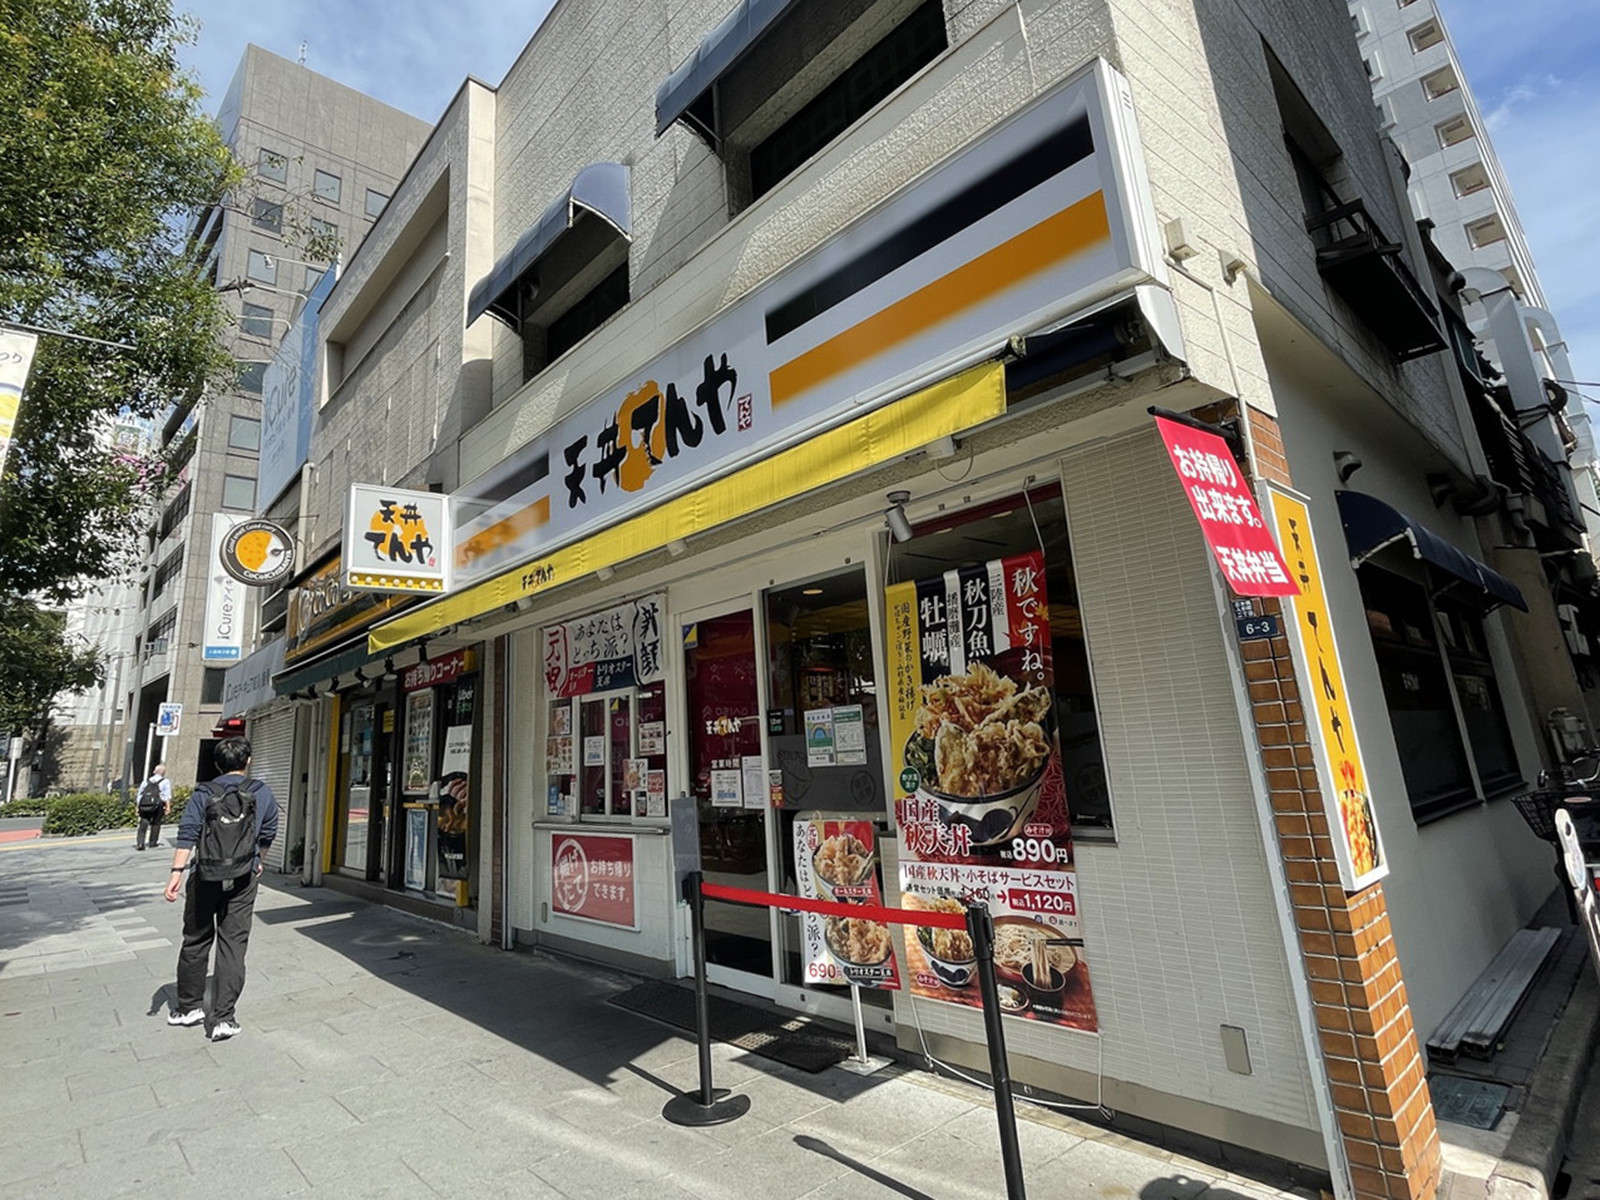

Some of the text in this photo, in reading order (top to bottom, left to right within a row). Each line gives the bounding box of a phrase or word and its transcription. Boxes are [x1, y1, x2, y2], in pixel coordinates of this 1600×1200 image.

[564, 352, 738, 509] 天丼てんや
[738, 393, 752, 432] てんや
[1174, 444, 1238, 489] お持帰り
[379, 499, 422, 526] 天丼
[1191, 485, 1263, 529] 出来ます。
[364, 531, 434, 565] てんや
[1215, 545, 1290, 585] 天丼弁当
[574, 613, 625, 641] あなたは
[920, 595, 950, 667] 牡蠣
[963, 577, 992, 658] 秋刀魚
[1011, 566, 1046, 681] 秋ですね。
[1245, 621, 1270, 635] 6-3
[902, 798, 940, 823] 国産
[903, 823, 973, 858] 秋天丼
[590, 860, 632, 878] お持ち帰り
[903, 865, 1074, 890] 国産秋天丼・小そばサービスセット
